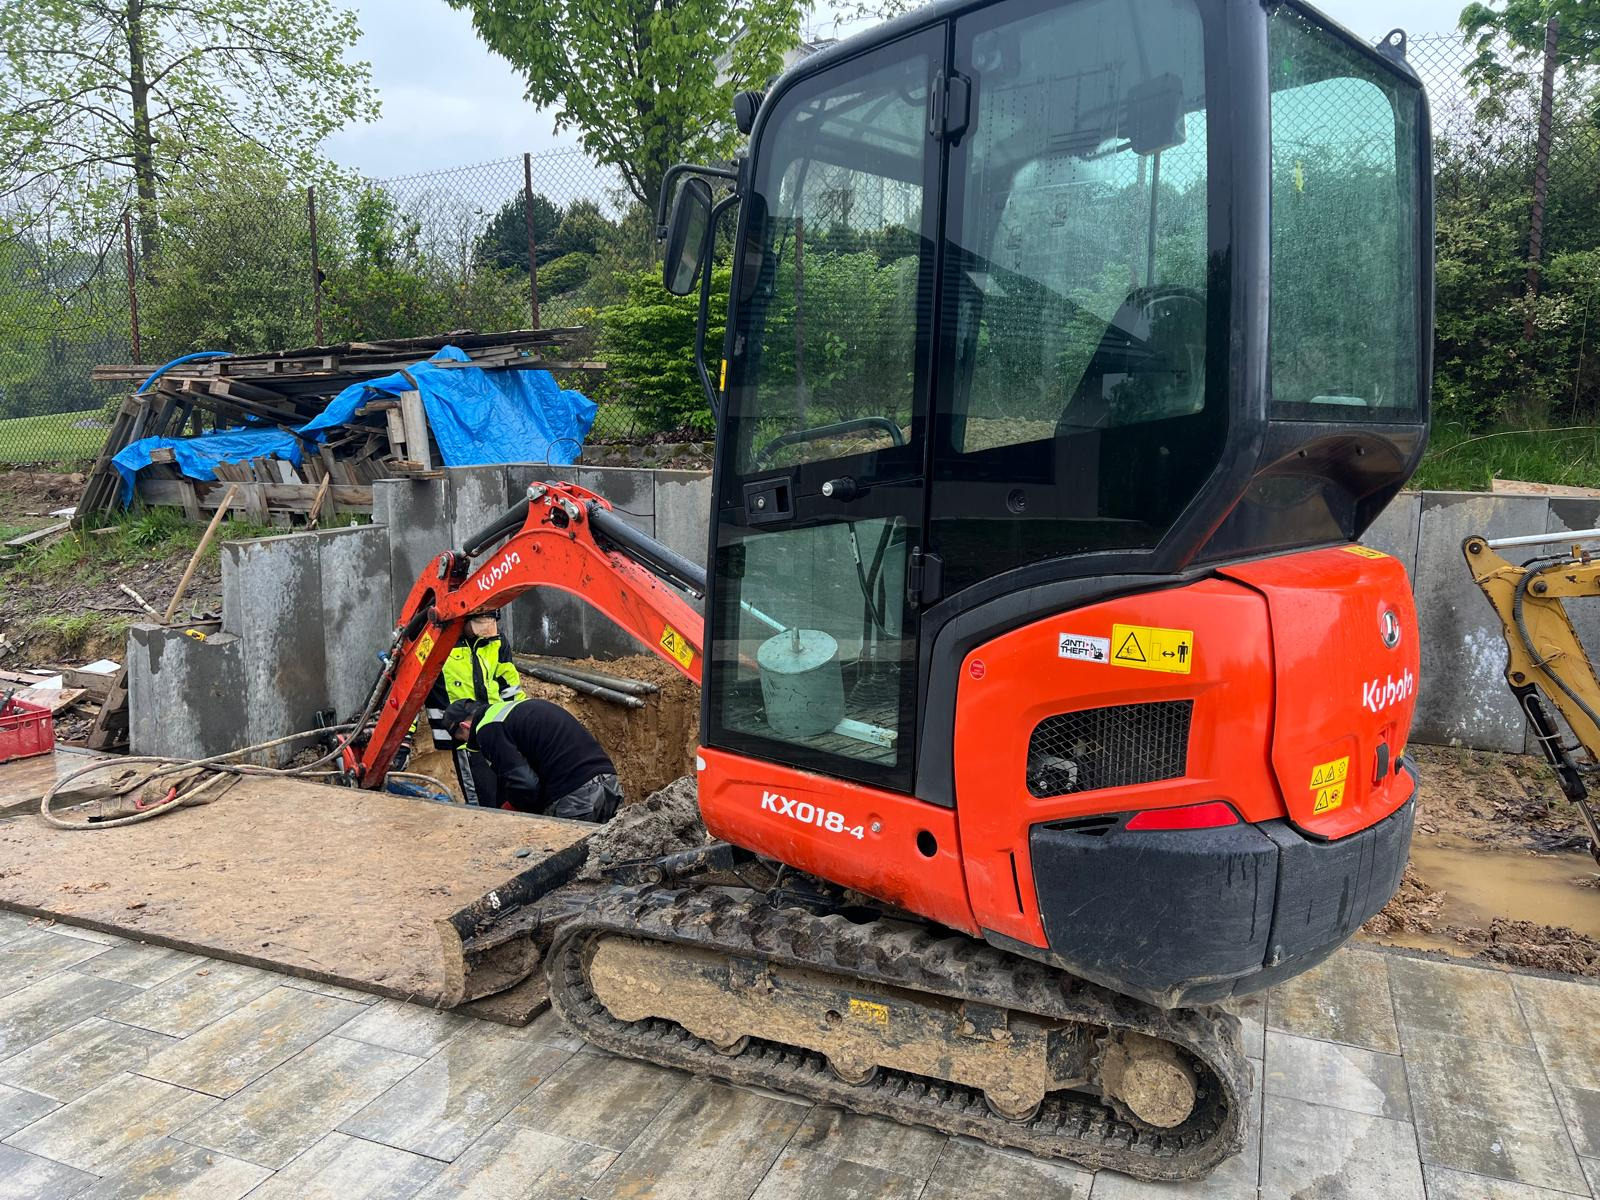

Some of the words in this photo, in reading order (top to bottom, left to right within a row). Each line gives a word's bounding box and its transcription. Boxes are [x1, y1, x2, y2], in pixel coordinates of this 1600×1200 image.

[477, 551, 521, 591] Kubota
[1060, 646, 1090, 656] THEFT
[1061, 639, 1086, 648] ANTI
[1362, 667, 1413, 713] Kubota
[760, 791, 865, 840] KX018-4
